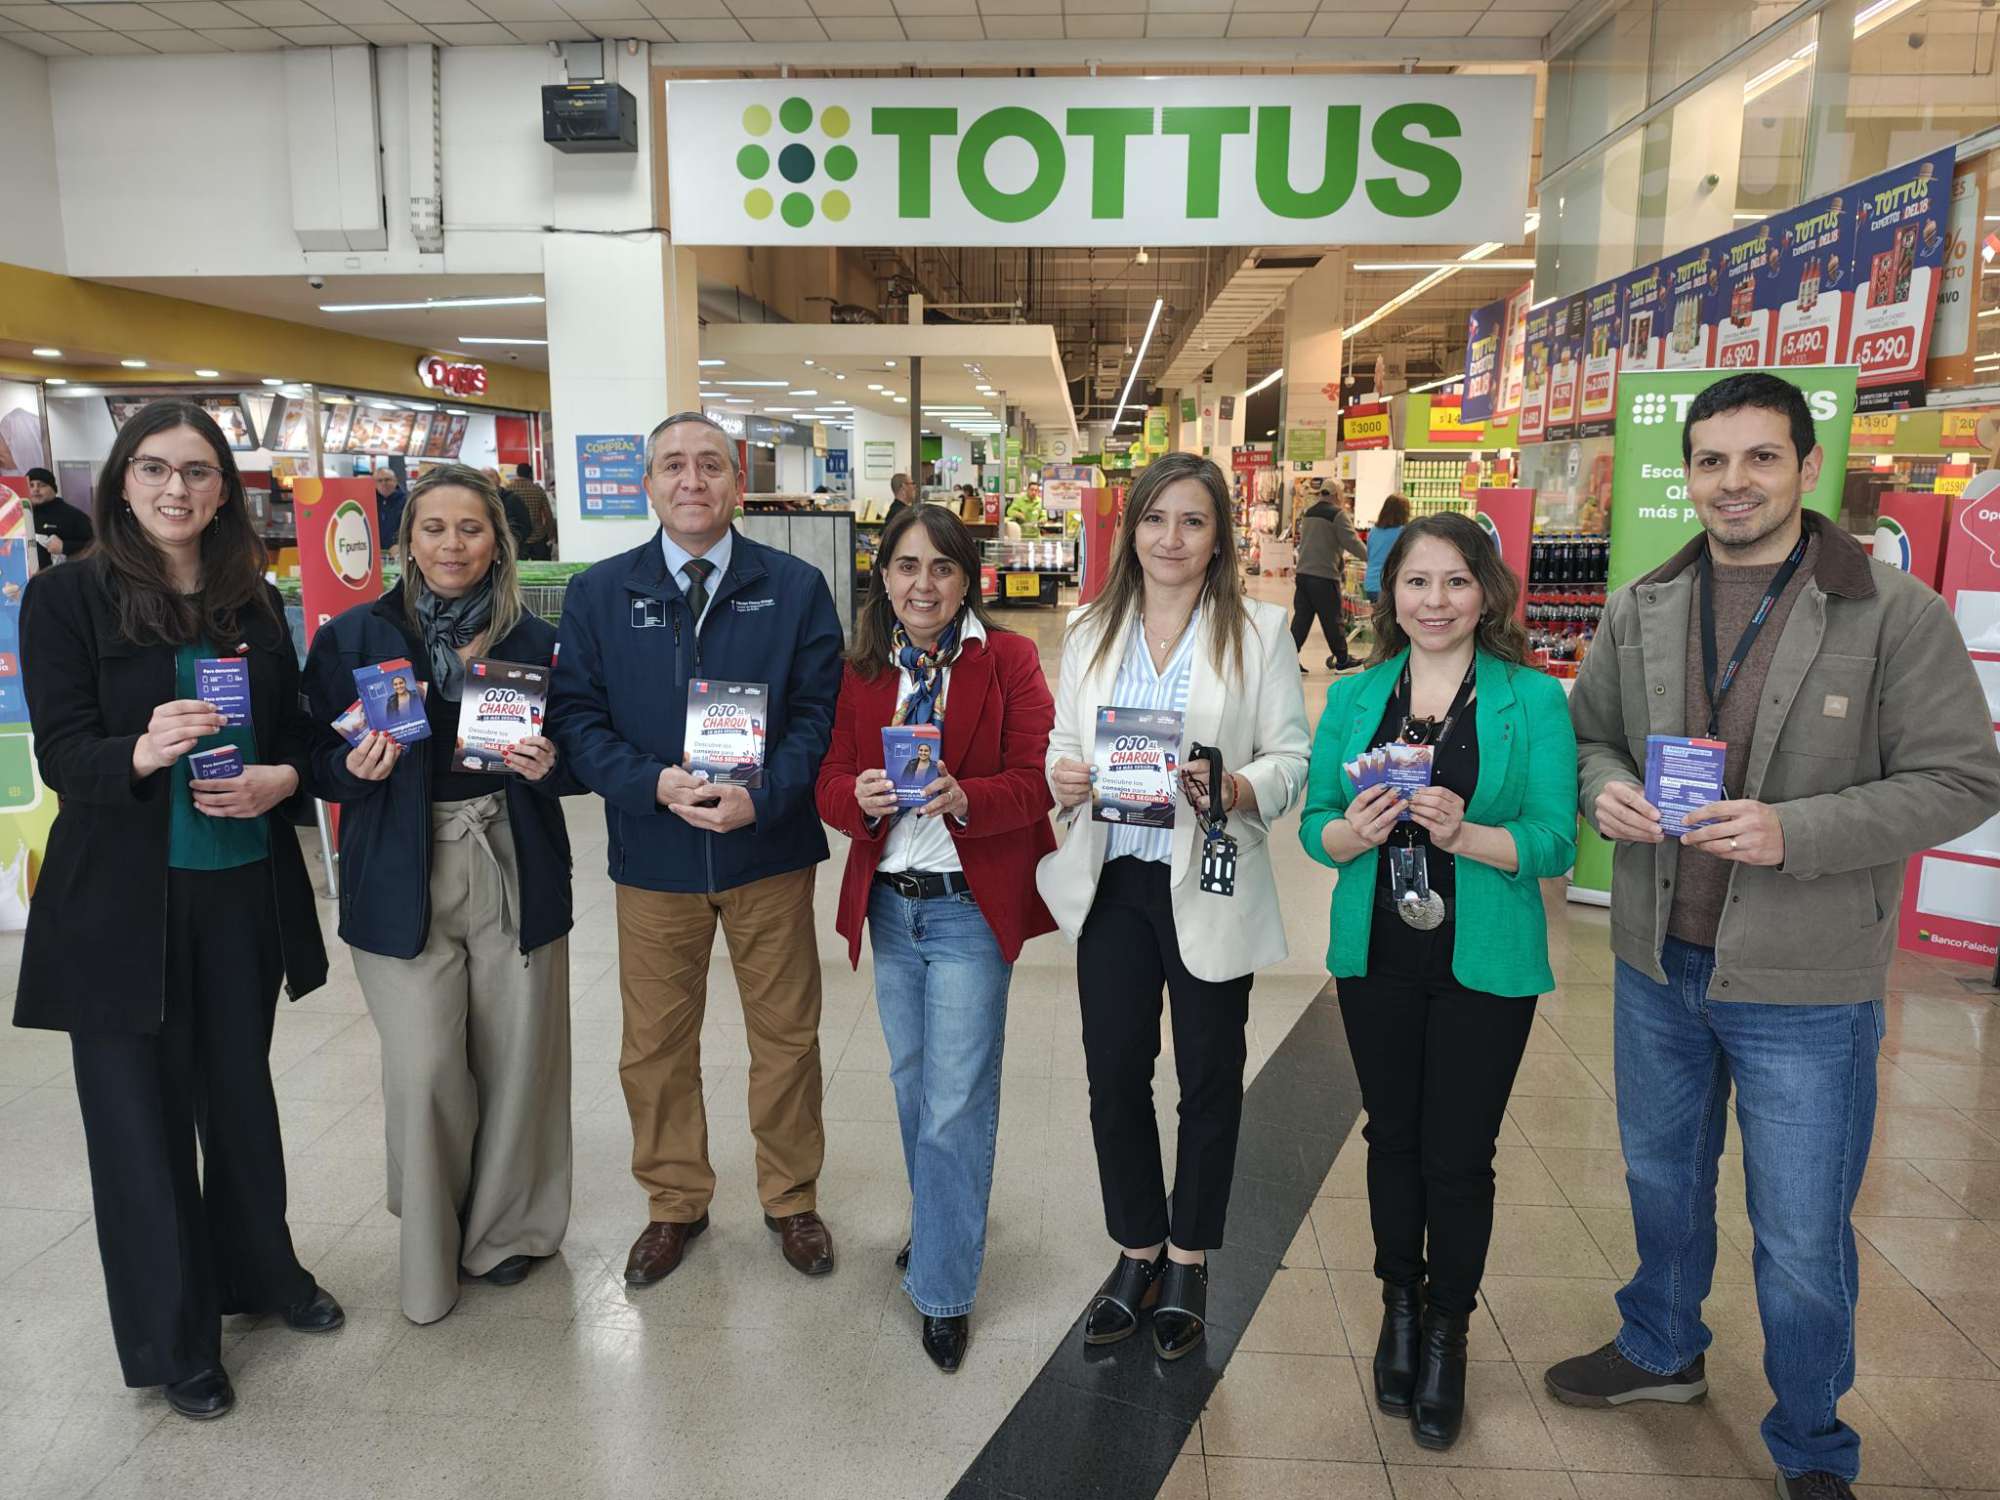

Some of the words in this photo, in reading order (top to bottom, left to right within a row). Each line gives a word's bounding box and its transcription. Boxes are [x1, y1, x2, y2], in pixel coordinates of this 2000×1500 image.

[872, 103, 1462, 222] TOTTUS
[1875, 178, 1929, 216] TOTTUS
[1795, 211, 1839, 243] TOTTUS
[1730, 237, 1768, 265] TOTTUS
[1472, 335, 1497, 362] TOTTUS
[1358, 420, 1382, 433] 3000
[1638, 504, 1678, 519] más
[485, 688, 517, 702] OJO
[479, 702, 526, 715] CHARQUI
[707, 704, 737, 717] OJO
[702, 717, 748, 729] CHARQUI
[1115, 736, 1148, 751] OJO
[1110, 751, 1161, 764] CHARQUI
[1120, 792, 1135, 800] MÁS
[1136, 794, 1165, 803] SEGURO
[1930, 933, 1962, 948] Banco
